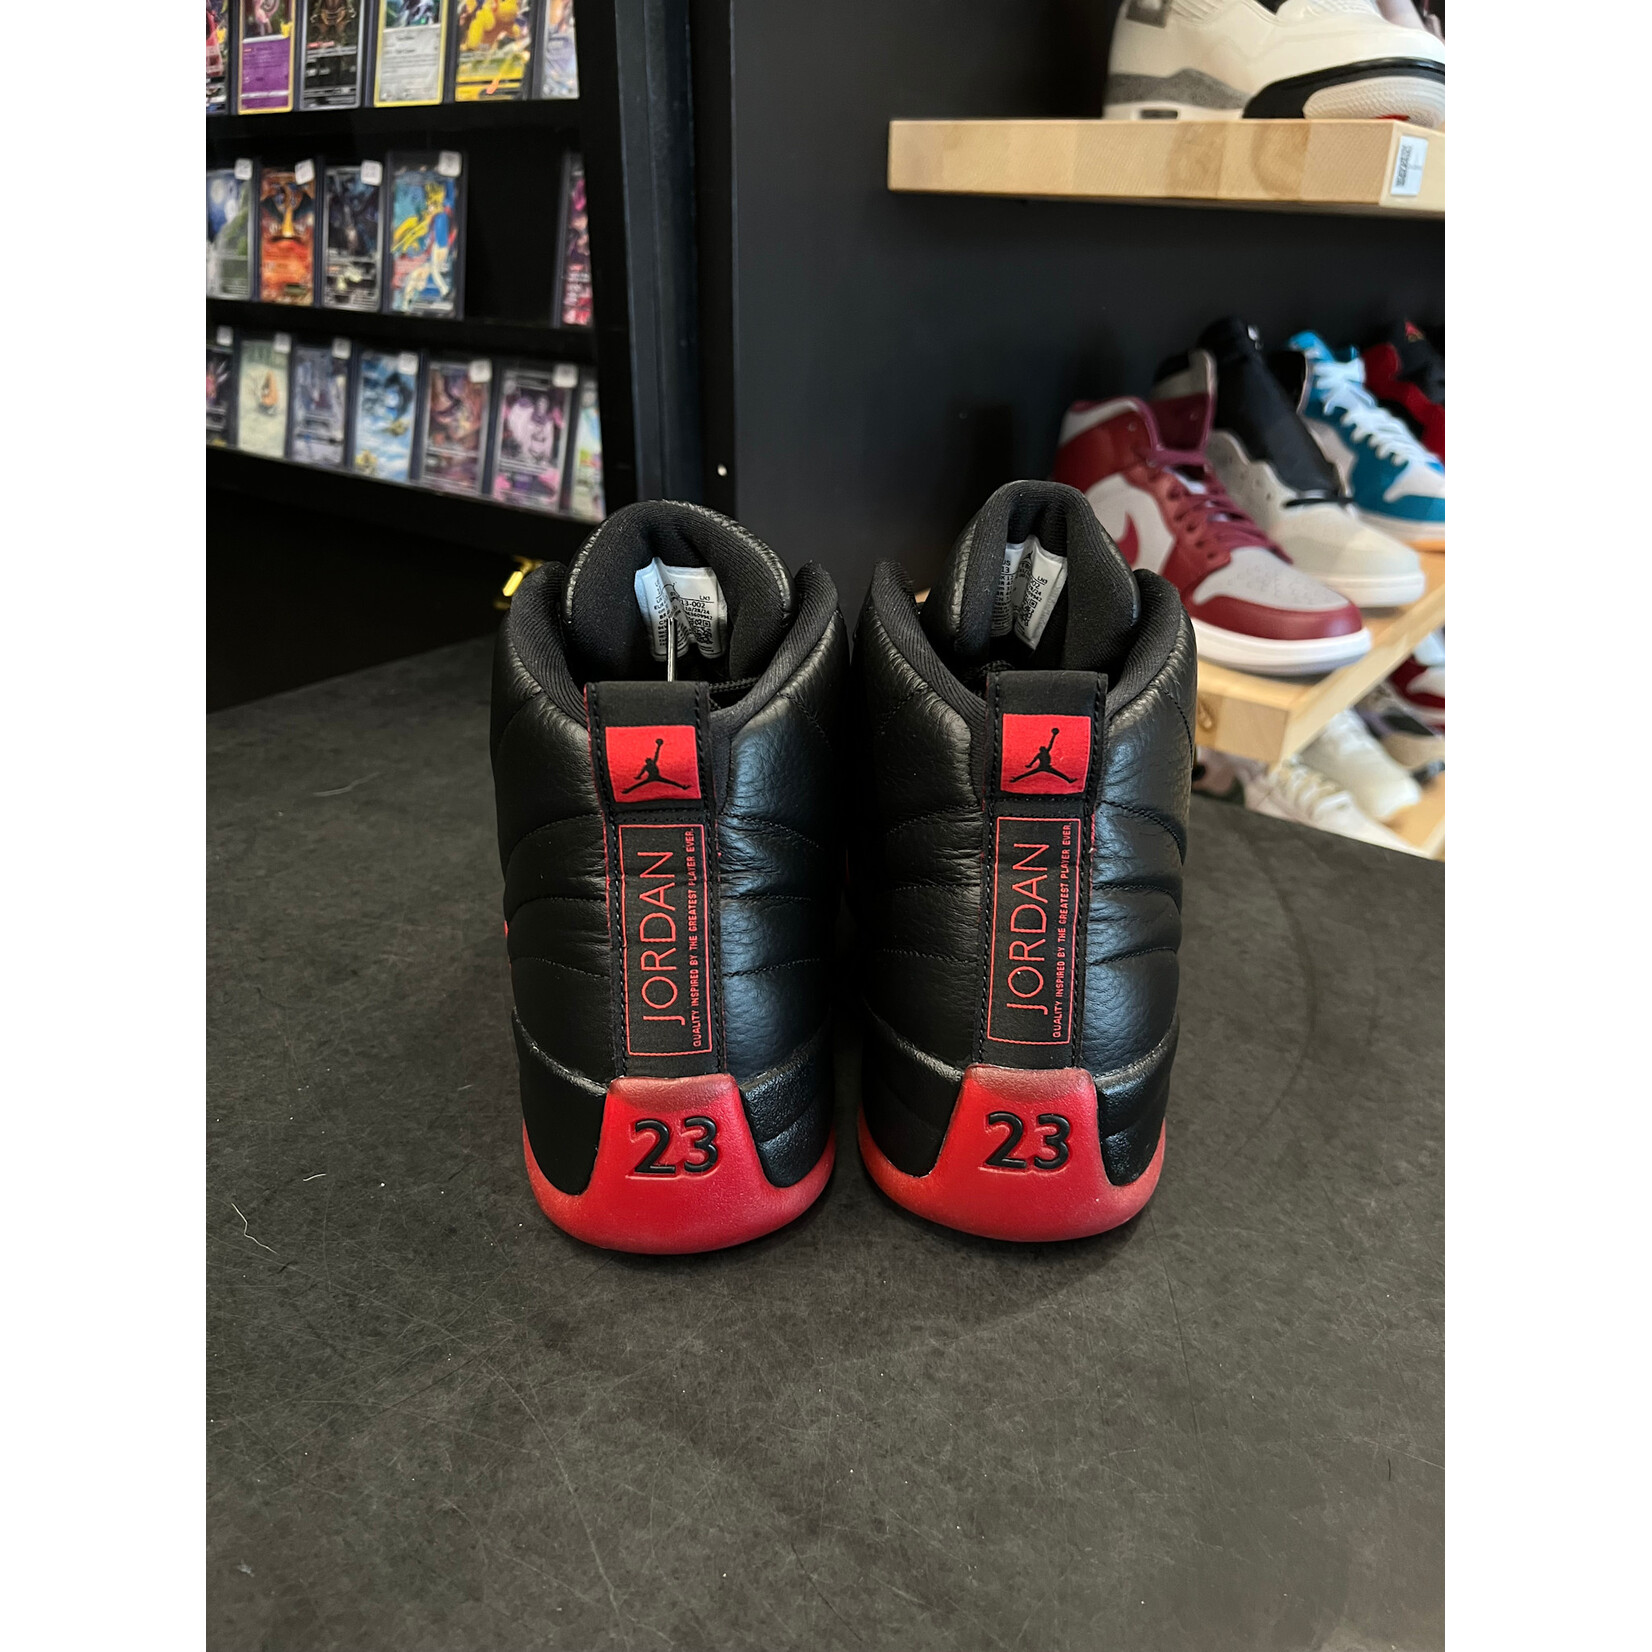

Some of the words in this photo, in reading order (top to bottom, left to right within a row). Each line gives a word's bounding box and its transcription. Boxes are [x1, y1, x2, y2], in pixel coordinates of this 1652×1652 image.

[687, 856, 697, 886] PLAYER
[1060, 849, 1071, 880] PLAYER
[688, 889, 698, 932] GREATEST
[1059, 882, 1069, 925] GREATEST
[637, 852, 686, 1025] JORDAN
[689, 934, 698, 950] THE
[1006, 843, 1050, 1016] JORDAN
[1058, 927, 1067, 943] THE
[690, 955, 699, 965] BY
[1057, 947, 1066, 959] BY
[689, 969, 699, 1004] INSPIRED
[1055, 961, 1065, 998] INSPIRED
[692, 1009, 702, 1047] QUALITY
[1052, 1001, 1063, 1038] QUALITY
[634, 1116, 719, 1174] 23
[985, 1111, 1070, 1170] 23
